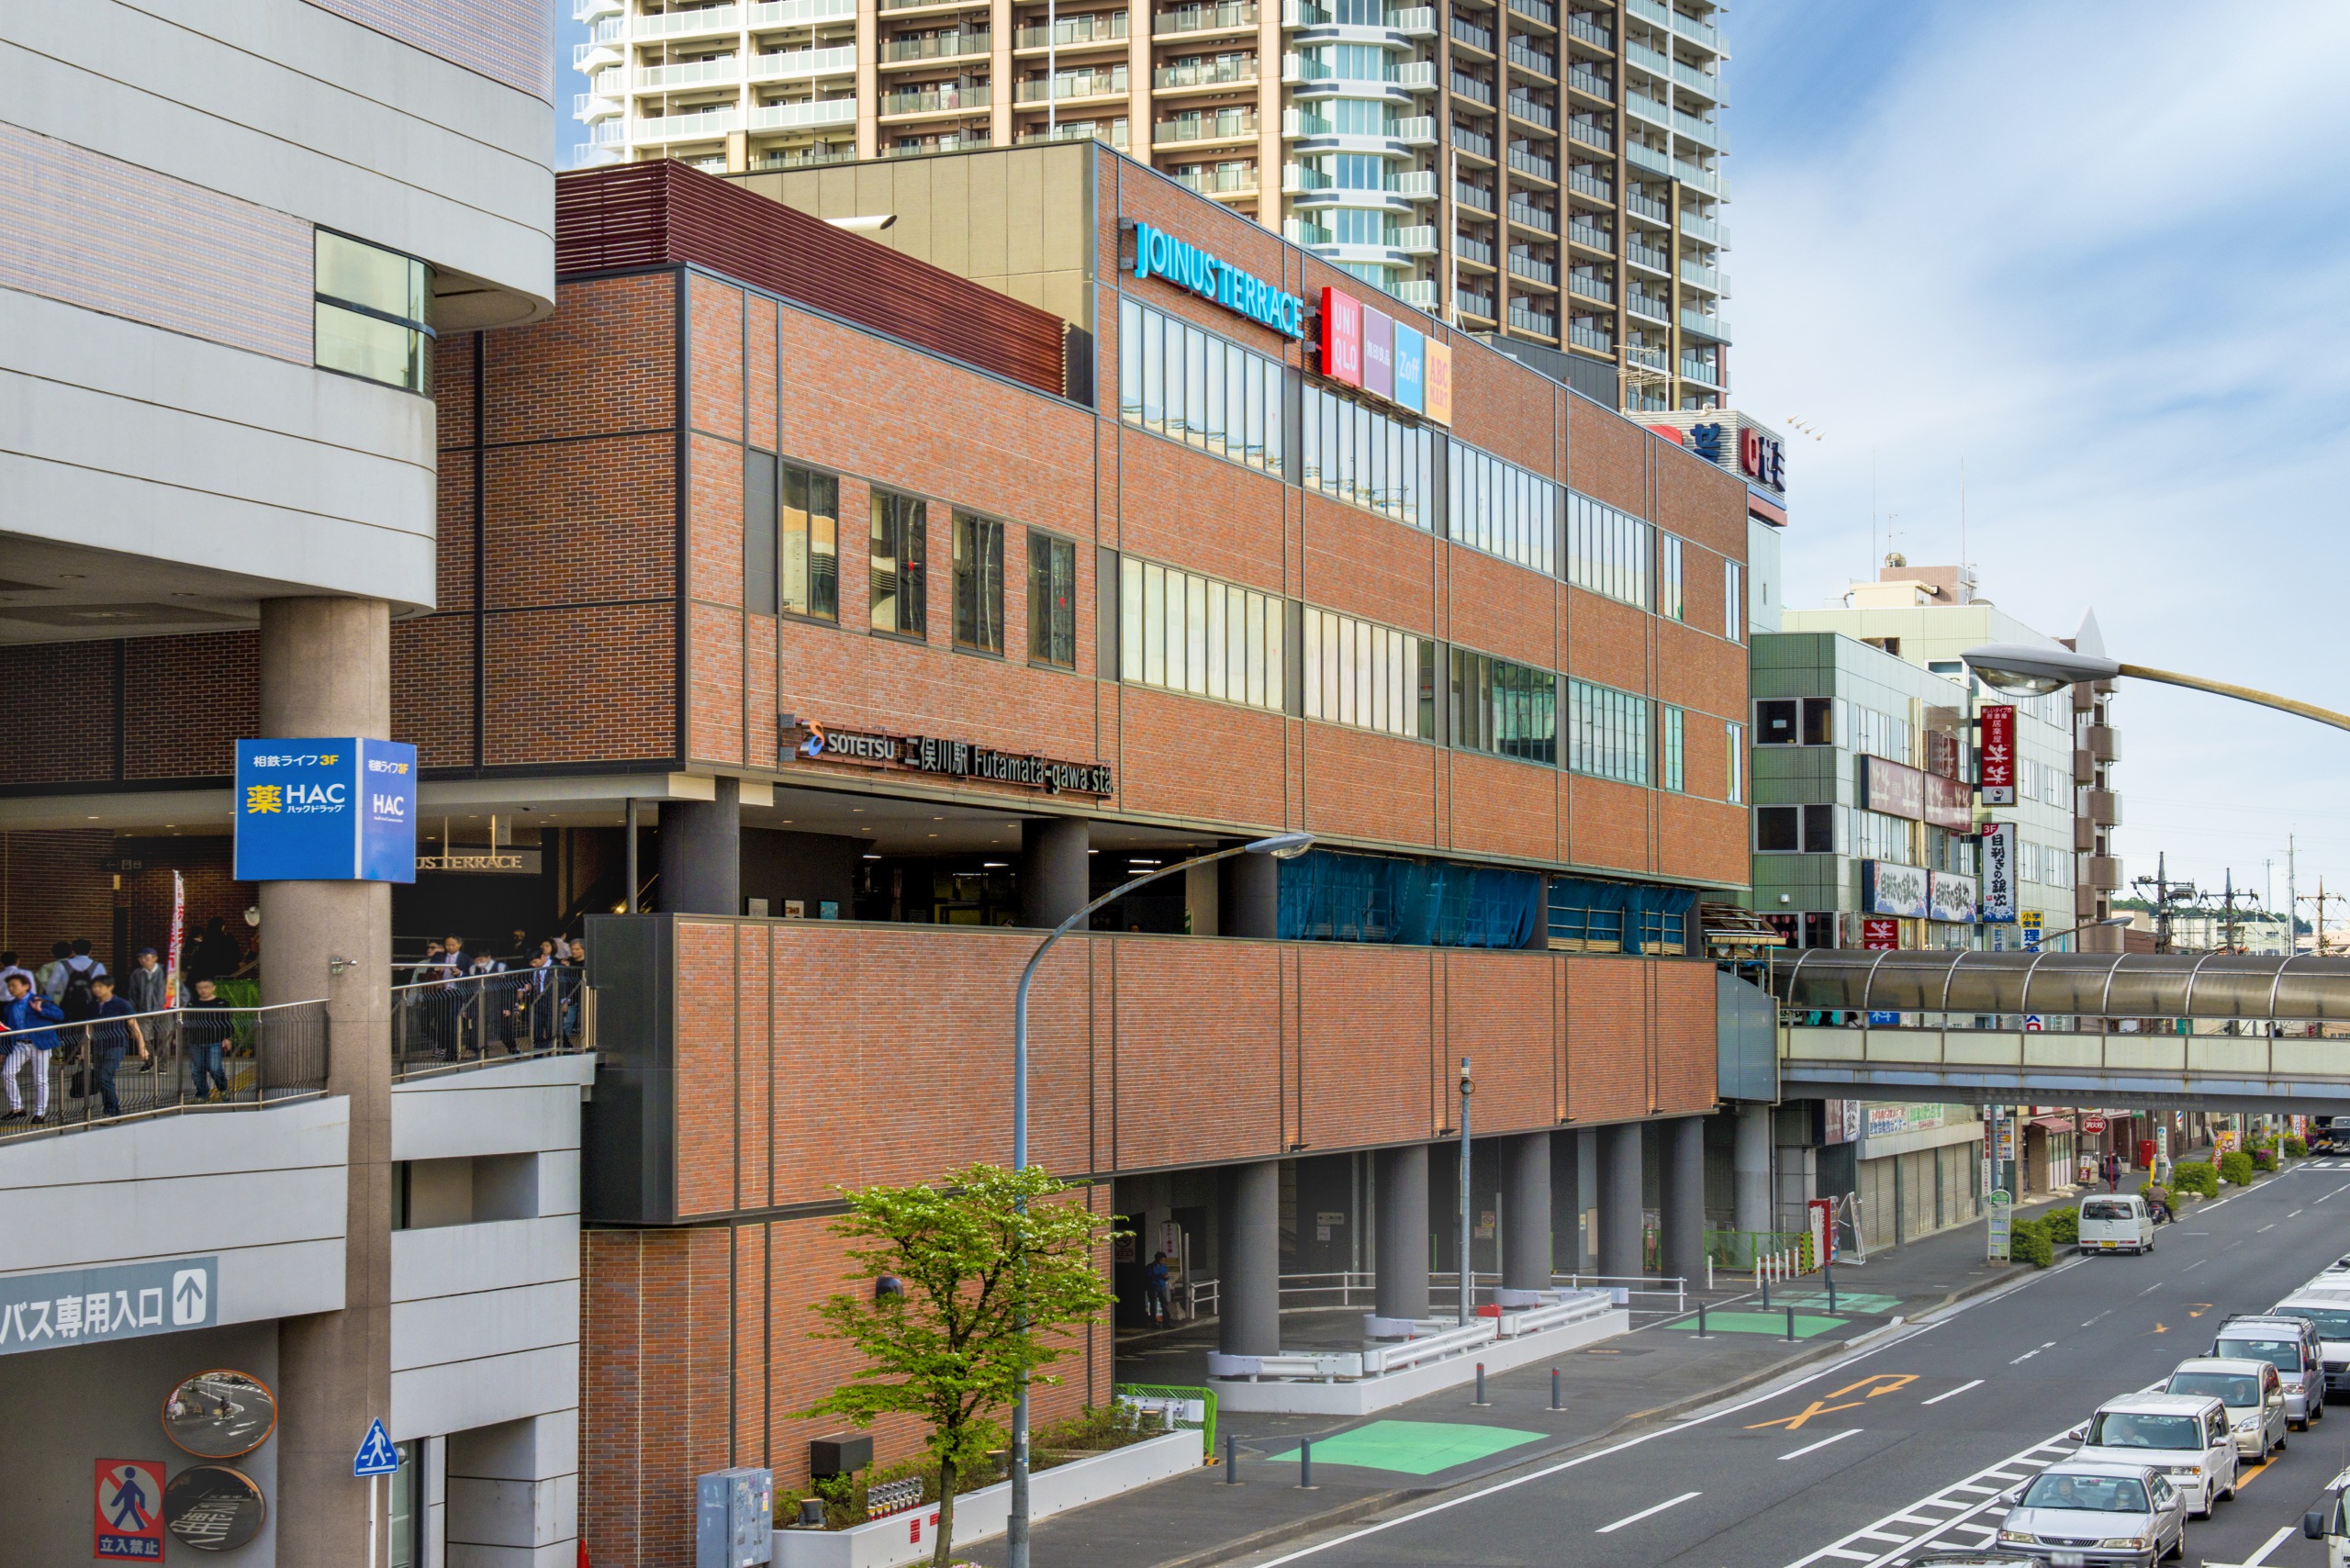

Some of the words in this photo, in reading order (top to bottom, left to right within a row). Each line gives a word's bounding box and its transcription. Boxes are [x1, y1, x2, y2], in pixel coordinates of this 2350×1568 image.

[1135, 222, 1216, 297] JOINUS
[1216, 260, 1304, 339] TERRACE
[1334, 301, 1355, 338] UNI
[1335, 337, 1357, 372] QLO
[1366, 340, 1390, 367] 無印良品
[1399, 351, 1420, 384] Zoff
[1430, 355, 1448, 388] ABC
[1429, 385, 1448, 409] MART
[828, 734, 895, 759] SOTETSU
[905, 736, 968, 776] 二俣川駅
[974, 745, 1088, 794] Futamata-gawa
[1091, 767, 1115, 793] sta.
[246, 784, 283, 814] 薬
[286, 783, 345, 804] HAC
[286, 804, 345, 813] ハックドラッグ
[373, 793, 404, 815] HAC
[1984, 824, 1997, 834] 3F
[442, 855, 522, 869] TERRACE
[1990, 834, 2008, 907] 目利きの銀次
[2086, 1121, 2104, 1129] 消火栓
[0, 1287, 163, 1345] バス専用入口
[100, 1537, 159, 1556] 立入禁止
